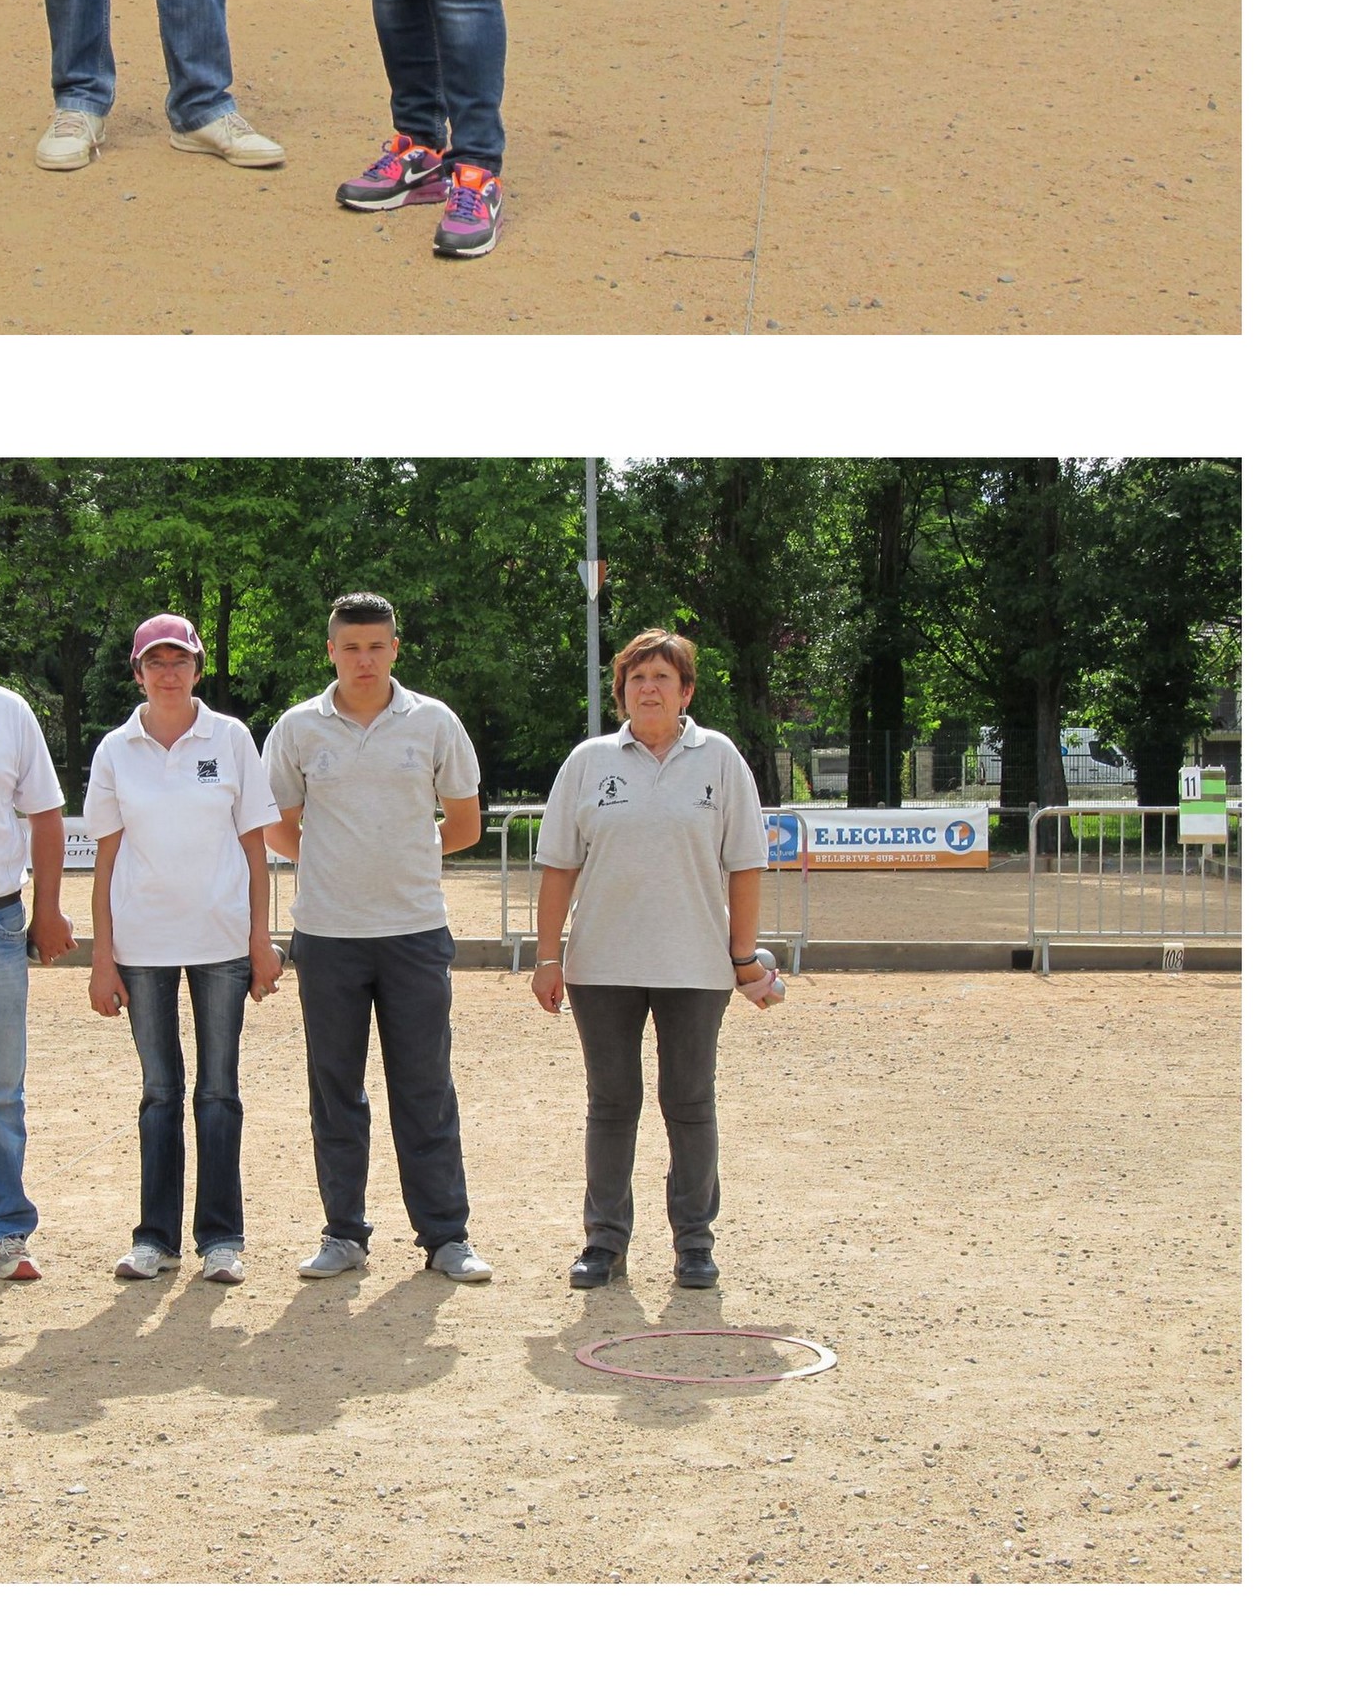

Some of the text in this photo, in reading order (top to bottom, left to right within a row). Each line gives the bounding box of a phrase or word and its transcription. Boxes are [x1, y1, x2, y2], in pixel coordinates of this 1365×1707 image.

[1184, 776, 1196, 797] 11
[814, 826, 937, 846] E.LECLERC
[815, 854, 938, 864] BELLERIVE-SUR-ALLIER
[1164, 948, 1184, 968] 108
